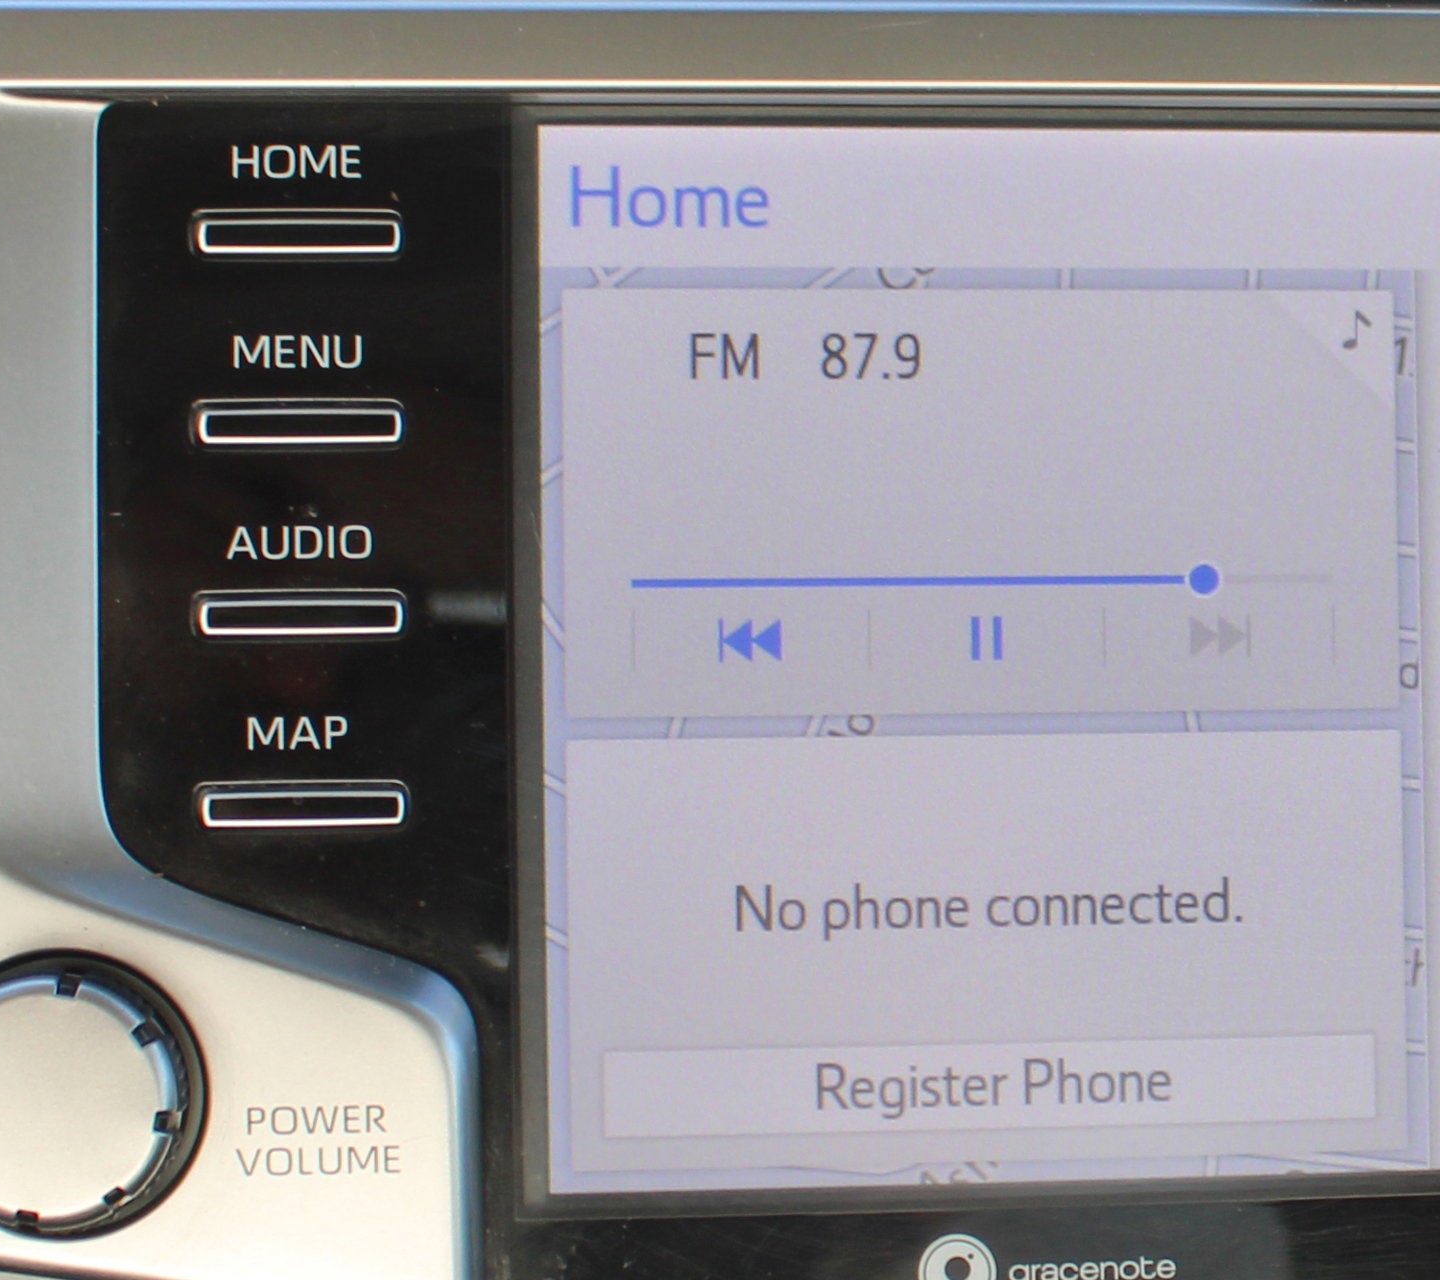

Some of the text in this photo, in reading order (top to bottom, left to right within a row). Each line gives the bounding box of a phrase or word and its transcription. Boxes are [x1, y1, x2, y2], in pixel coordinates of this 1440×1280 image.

[230, 144, 363, 179] HOME
[568, 165, 770, 230] Home
[231, 334, 364, 369] MENU
[689, 332, 923, 381] FM 87.9
[226, 525, 373, 561] AUDIO
[246, 716, 349, 750] MAP
[734, 876, 1244, 941] No phone connected.
[814, 1058, 1172, 1119] Register Phone
[245, 1104, 388, 1136] POWER
[235, 1144, 402, 1177] VOLUME
